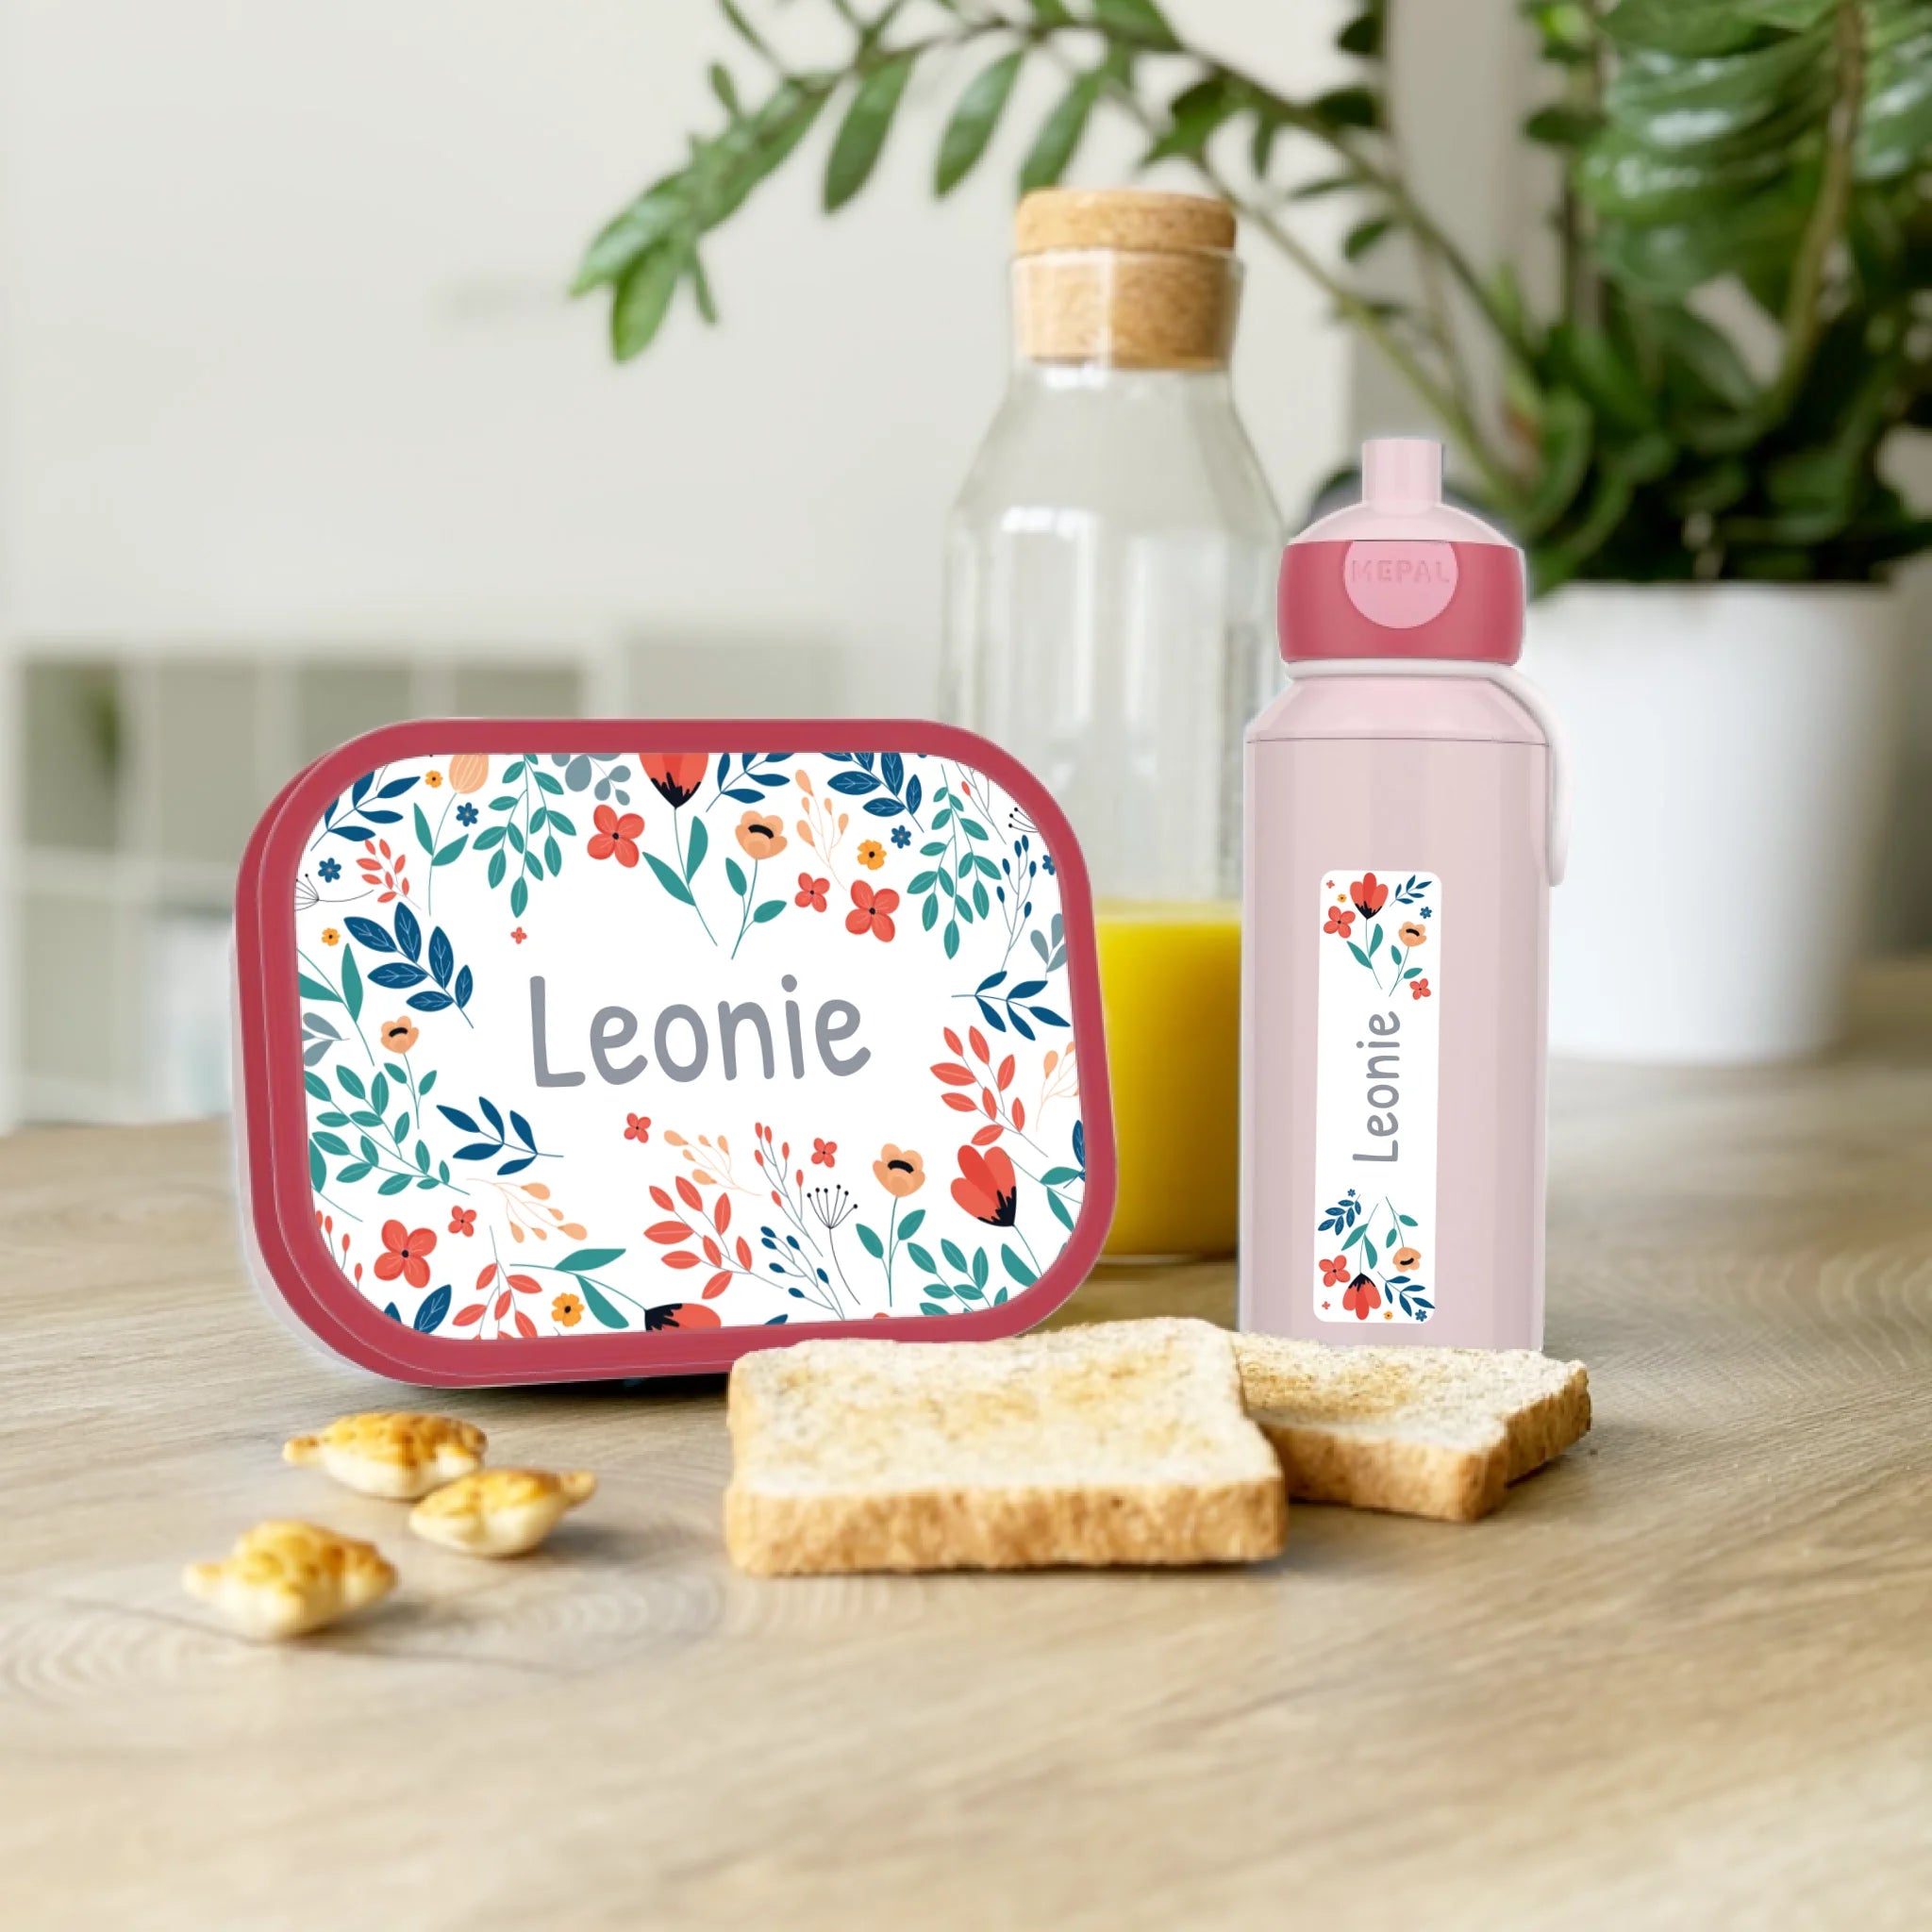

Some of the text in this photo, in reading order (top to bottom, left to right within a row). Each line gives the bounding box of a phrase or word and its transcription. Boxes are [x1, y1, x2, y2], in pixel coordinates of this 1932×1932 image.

[1351, 559, 1450, 583] MEPAL
[529, 974, 872, 1088] Leonie
[1353, 1010, 1401, 1162] Leonie
